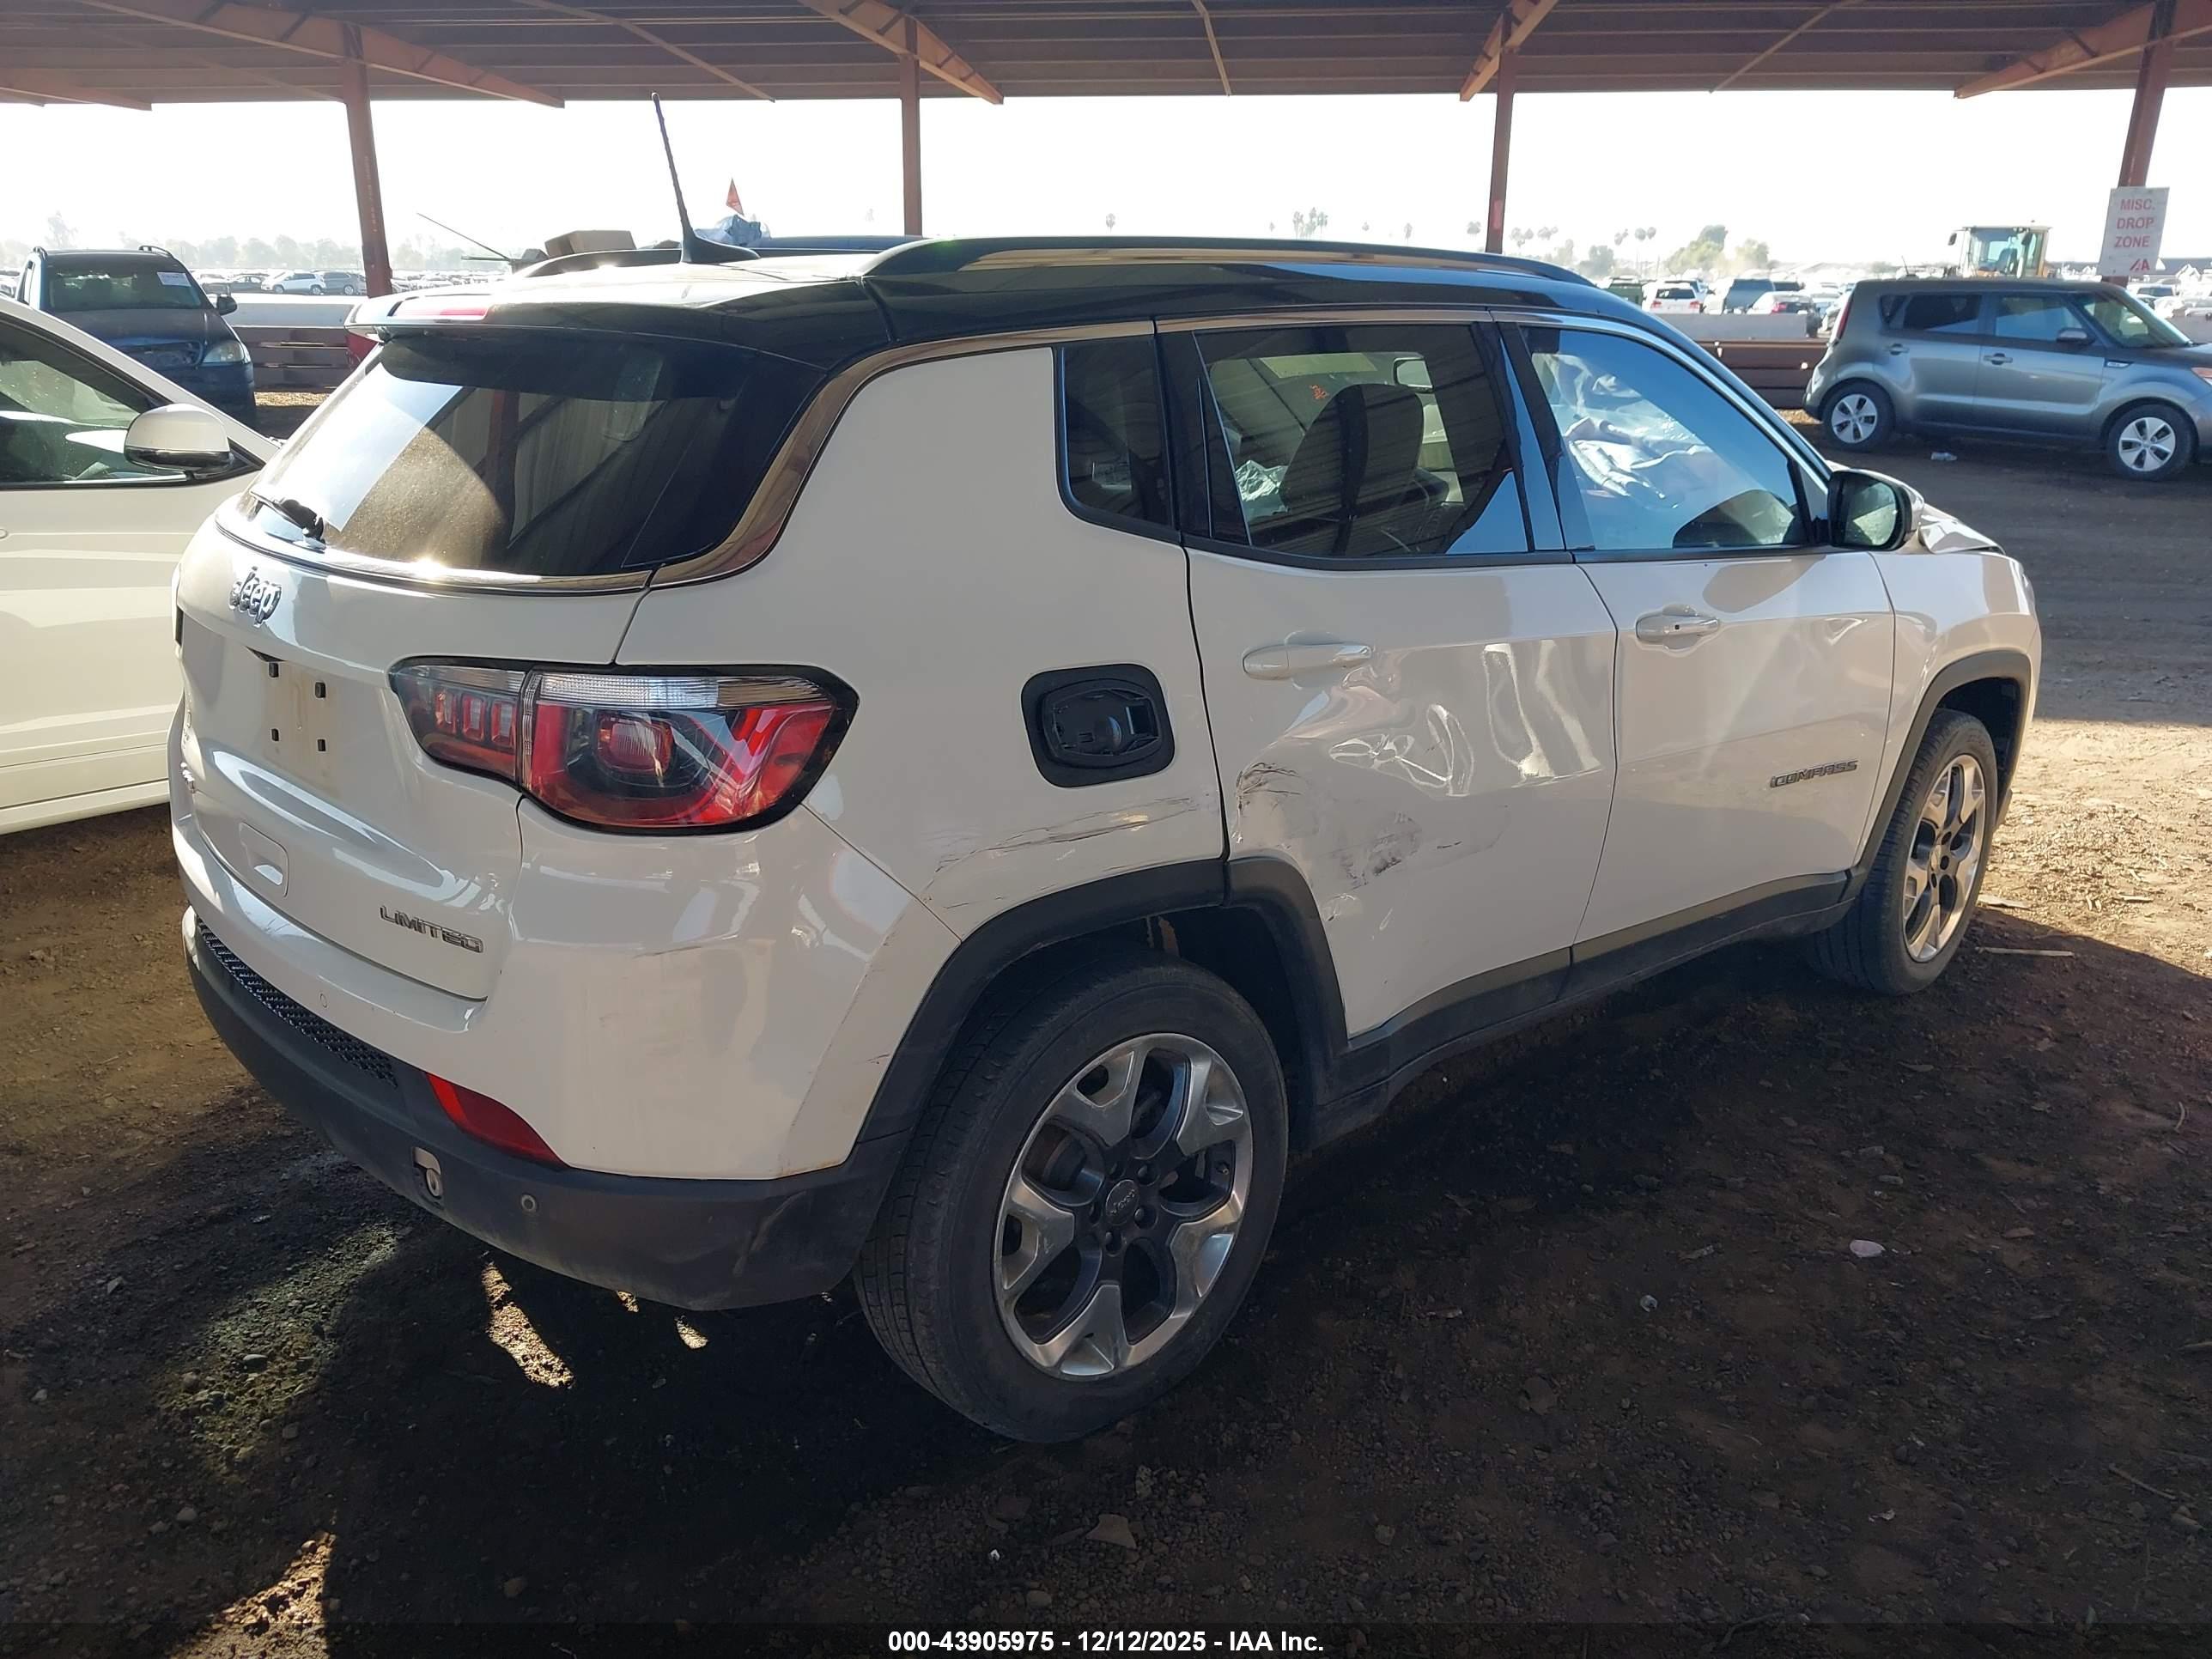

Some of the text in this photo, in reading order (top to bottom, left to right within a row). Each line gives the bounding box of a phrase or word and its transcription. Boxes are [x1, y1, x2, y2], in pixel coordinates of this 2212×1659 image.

[2119, 198, 2155, 211] MISC.
[2116, 216, 2154, 229] DROP
[2114, 235, 2151, 248] ZONE
[228, 565, 283, 625] Jeep
[1769, 759, 1859, 788] COMPASS
[380, 904, 484, 954] LIMITED
